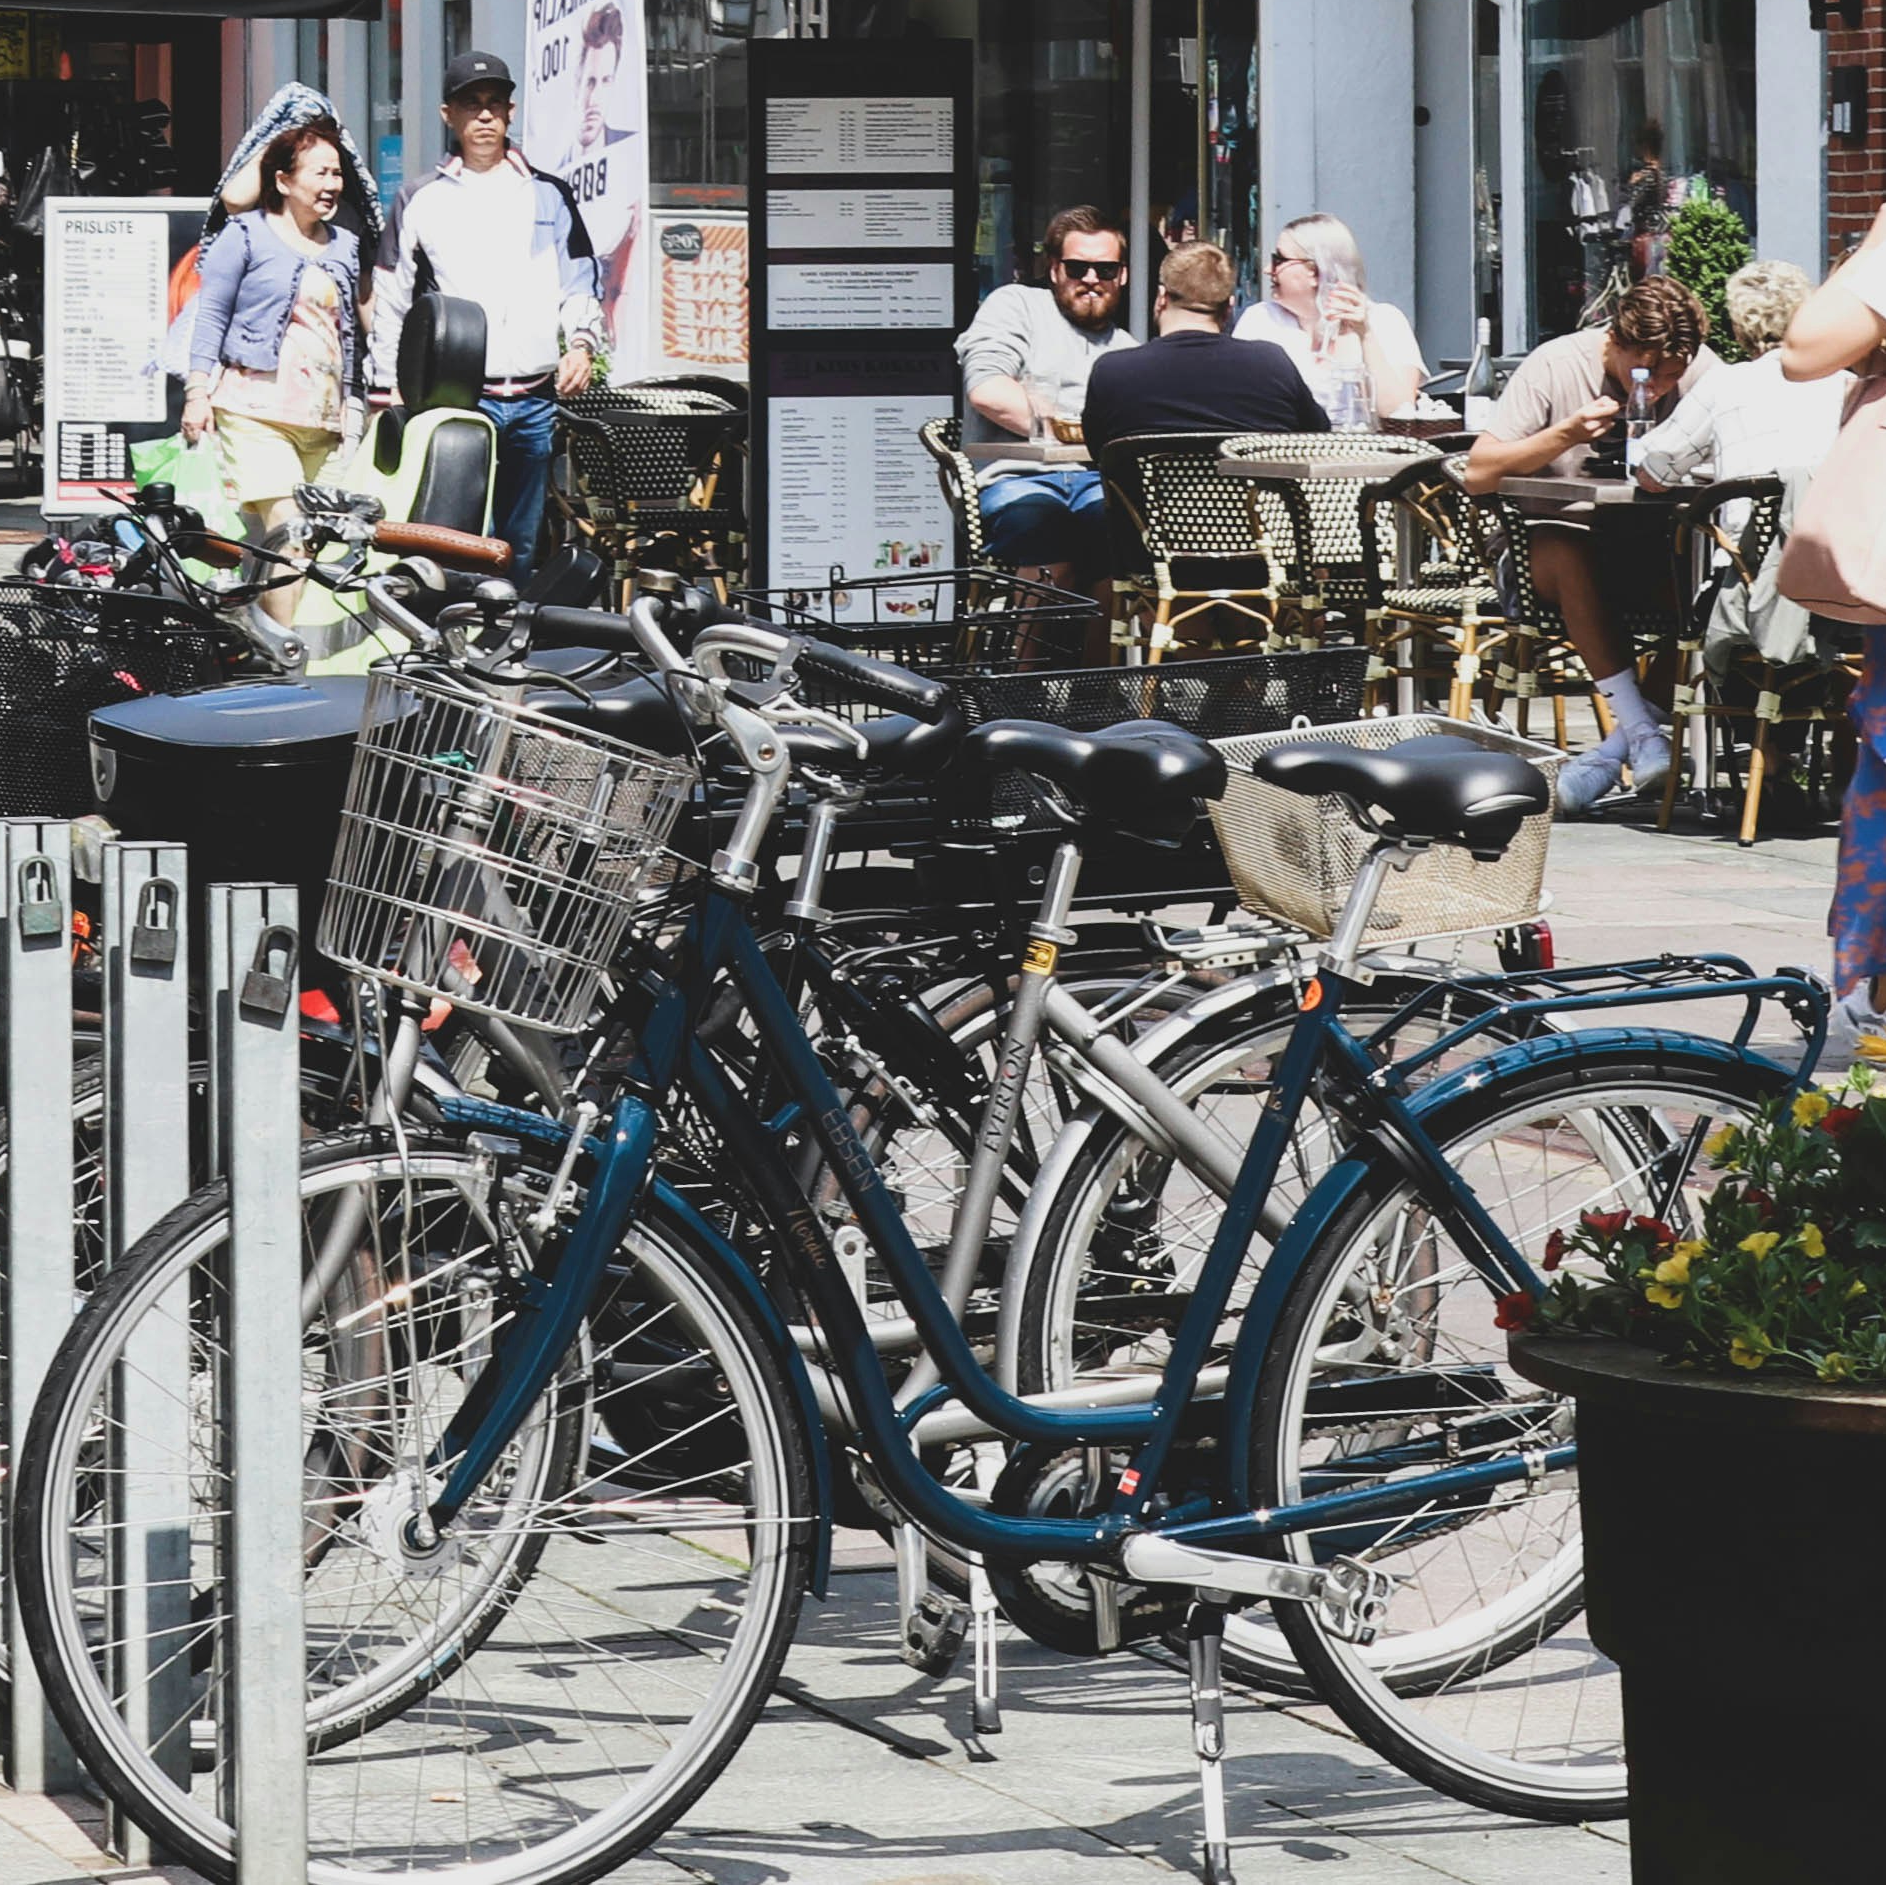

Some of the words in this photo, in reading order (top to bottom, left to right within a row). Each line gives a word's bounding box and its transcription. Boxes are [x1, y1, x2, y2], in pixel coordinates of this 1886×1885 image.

[64, 220, 134, 235] PRISLISTE
[983, 1037, 1026, 1153] EVERTON
[820, 1107, 879, 1193] EBSEN
